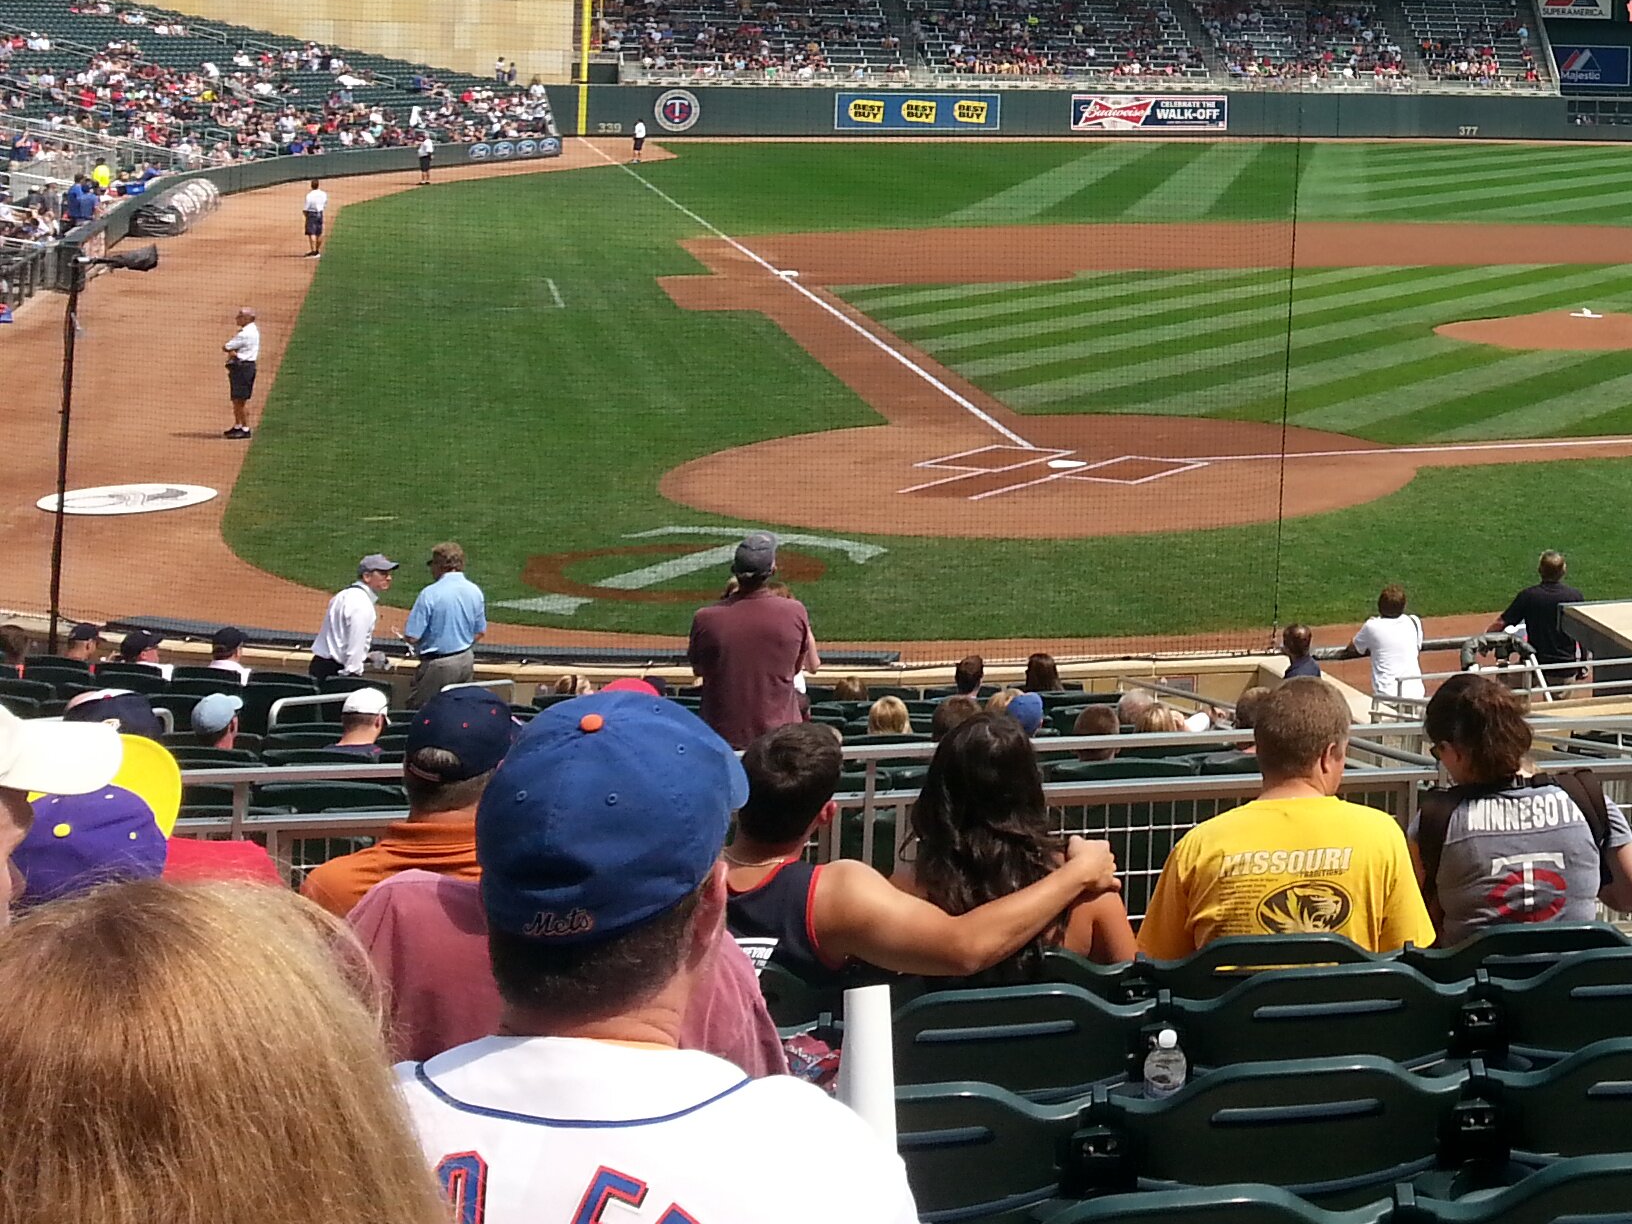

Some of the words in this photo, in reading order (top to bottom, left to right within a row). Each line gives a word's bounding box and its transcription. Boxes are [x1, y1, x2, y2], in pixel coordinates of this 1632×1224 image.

[1560, 71, 1601, 82] Majestic
[853, 103, 883, 112] BEST
[906, 104, 935, 113] BEST
[957, 104, 985, 113] BEST
[1160, 100, 1201, 108] CELEBRATE
[853, 111, 879, 119] BUY
[906, 111, 931, 119] BUY
[958, 111, 982, 119] BUY
[1156, 108, 1220, 120] WALK-OFF
[598, 122, 622, 133] 339
[1459, 126, 1479, 136] 377
[1219, 847, 1353, 878] MISSOURI
[523, 907, 595, 936] Mets
